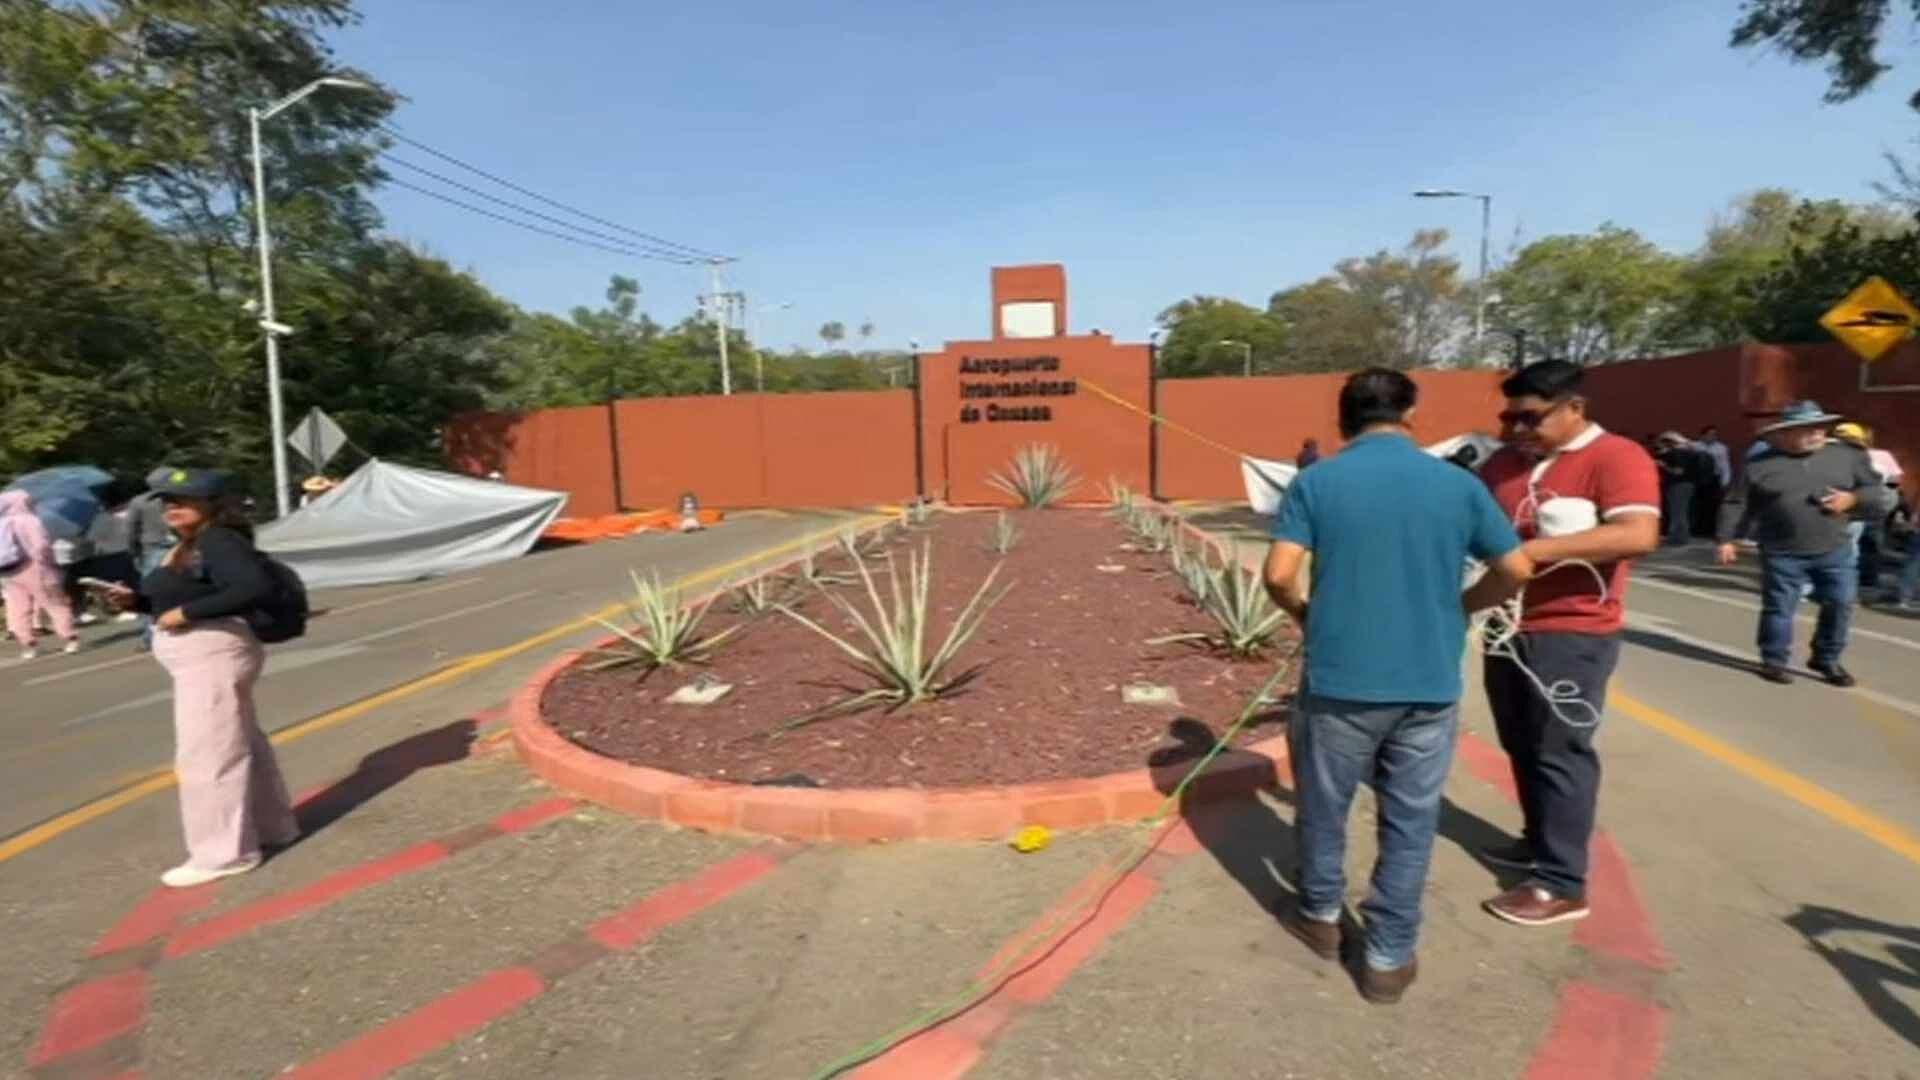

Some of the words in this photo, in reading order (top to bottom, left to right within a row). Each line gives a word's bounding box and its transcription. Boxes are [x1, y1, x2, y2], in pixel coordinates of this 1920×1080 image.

[960, 356, 1060, 375] Aeropuerto
[960, 379, 1077, 398] Internacional
[960, 404, 980, 422] de
